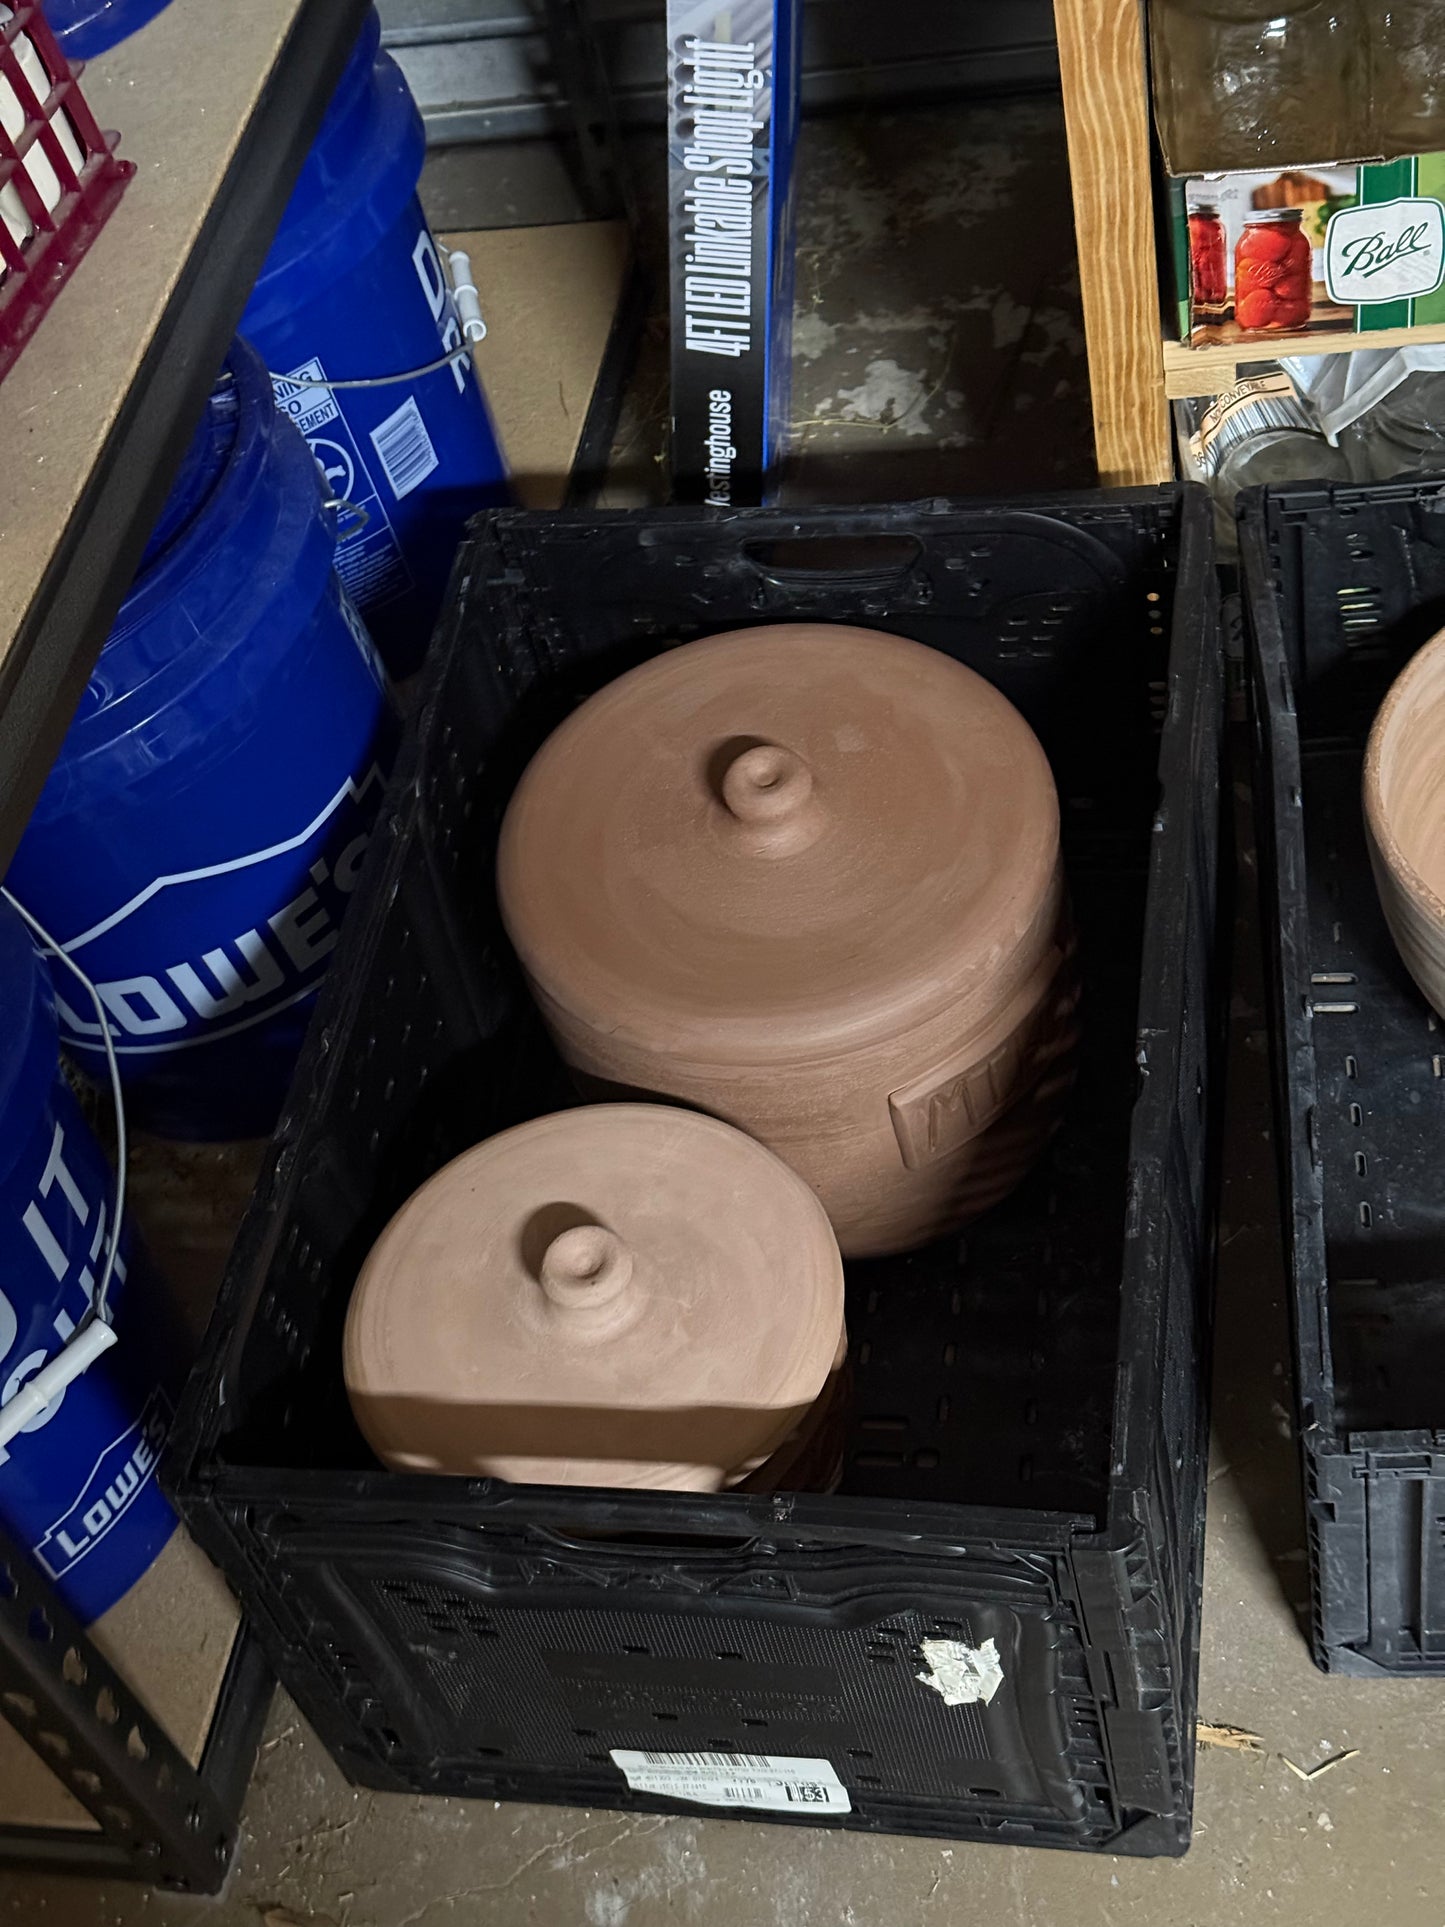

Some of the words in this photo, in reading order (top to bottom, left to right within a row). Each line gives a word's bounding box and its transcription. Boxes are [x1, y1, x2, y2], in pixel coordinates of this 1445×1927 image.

[683, 39, 764, 107] Light
[683, 110, 764, 175] Shop
[684, 176, 753, 277] Linkable
[1341, 221, 1432, 279] Ball
[685, 276, 751, 316] LED
[685, 314, 751, 357] 4FT
[56, 1408, 166, 1558] LOWE'S
